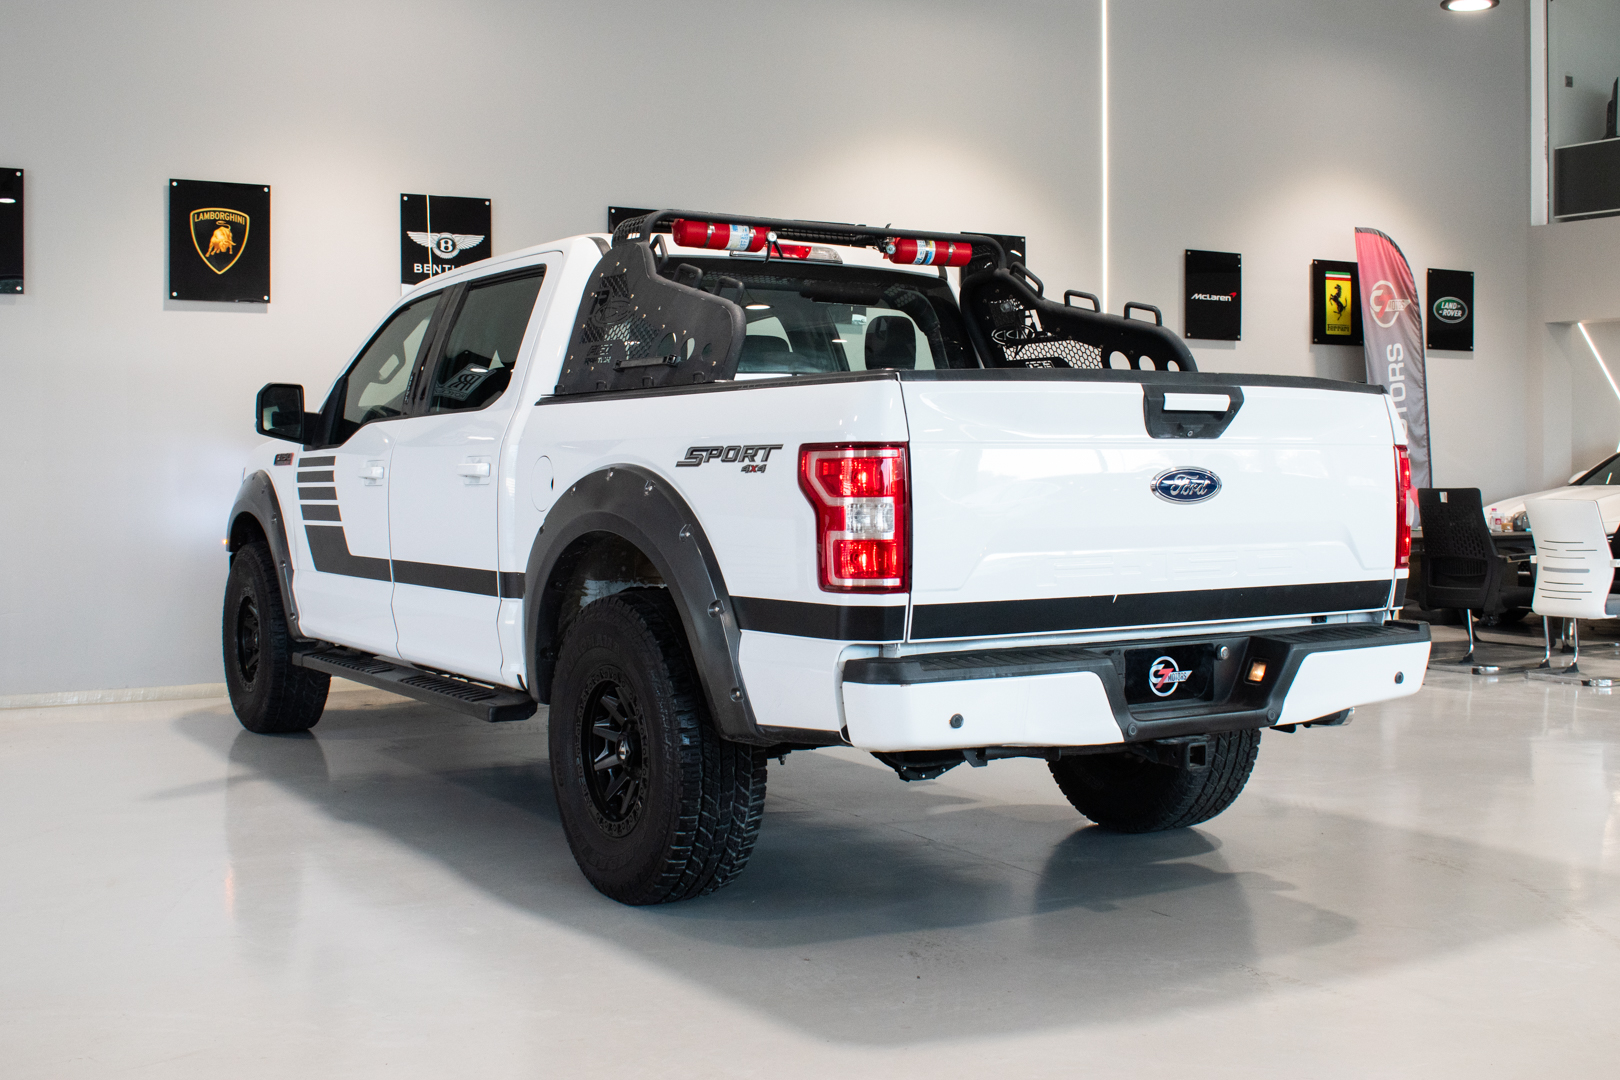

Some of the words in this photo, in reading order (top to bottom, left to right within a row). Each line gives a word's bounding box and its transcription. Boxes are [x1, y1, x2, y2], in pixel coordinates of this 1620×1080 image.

[194, 211, 246, 226] LAMBORGHINI
[1191, 293, 1232, 302] McLaren
[1441, 301, 1458, 309] LAND
[1442, 309, 1463, 317] ROVER
[675, 444, 784, 468] SPORT
[1170, 474, 1208, 496] Ford
